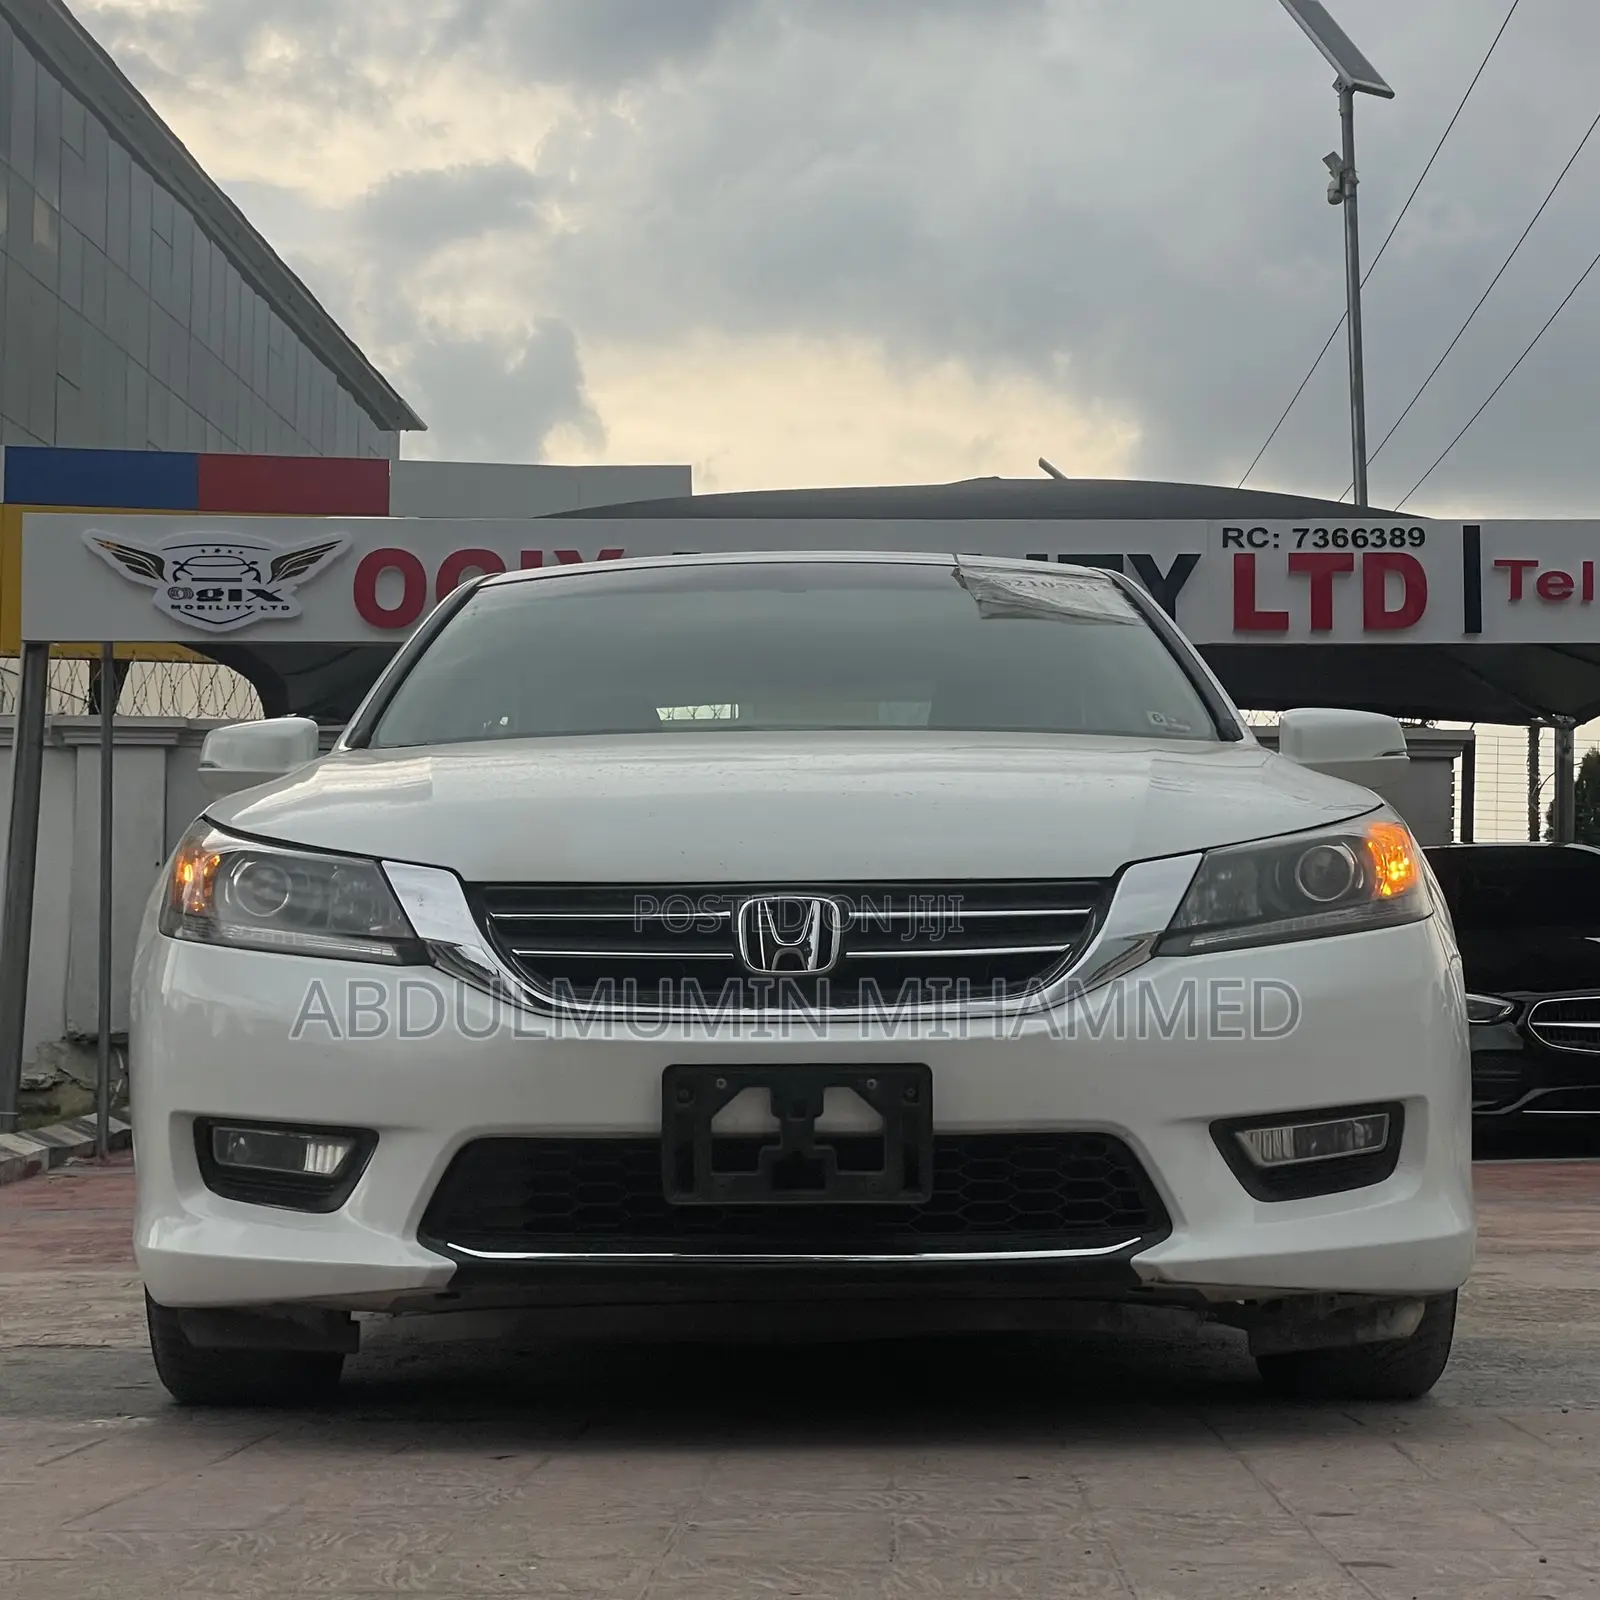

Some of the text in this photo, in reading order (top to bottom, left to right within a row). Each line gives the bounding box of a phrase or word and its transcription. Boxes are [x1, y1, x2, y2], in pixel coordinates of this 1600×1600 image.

[1222, 526, 1427, 549] RC: 7366389
[1233, 552, 1428, 631] LTD
[1493, 559, 1594, 601] Tel
